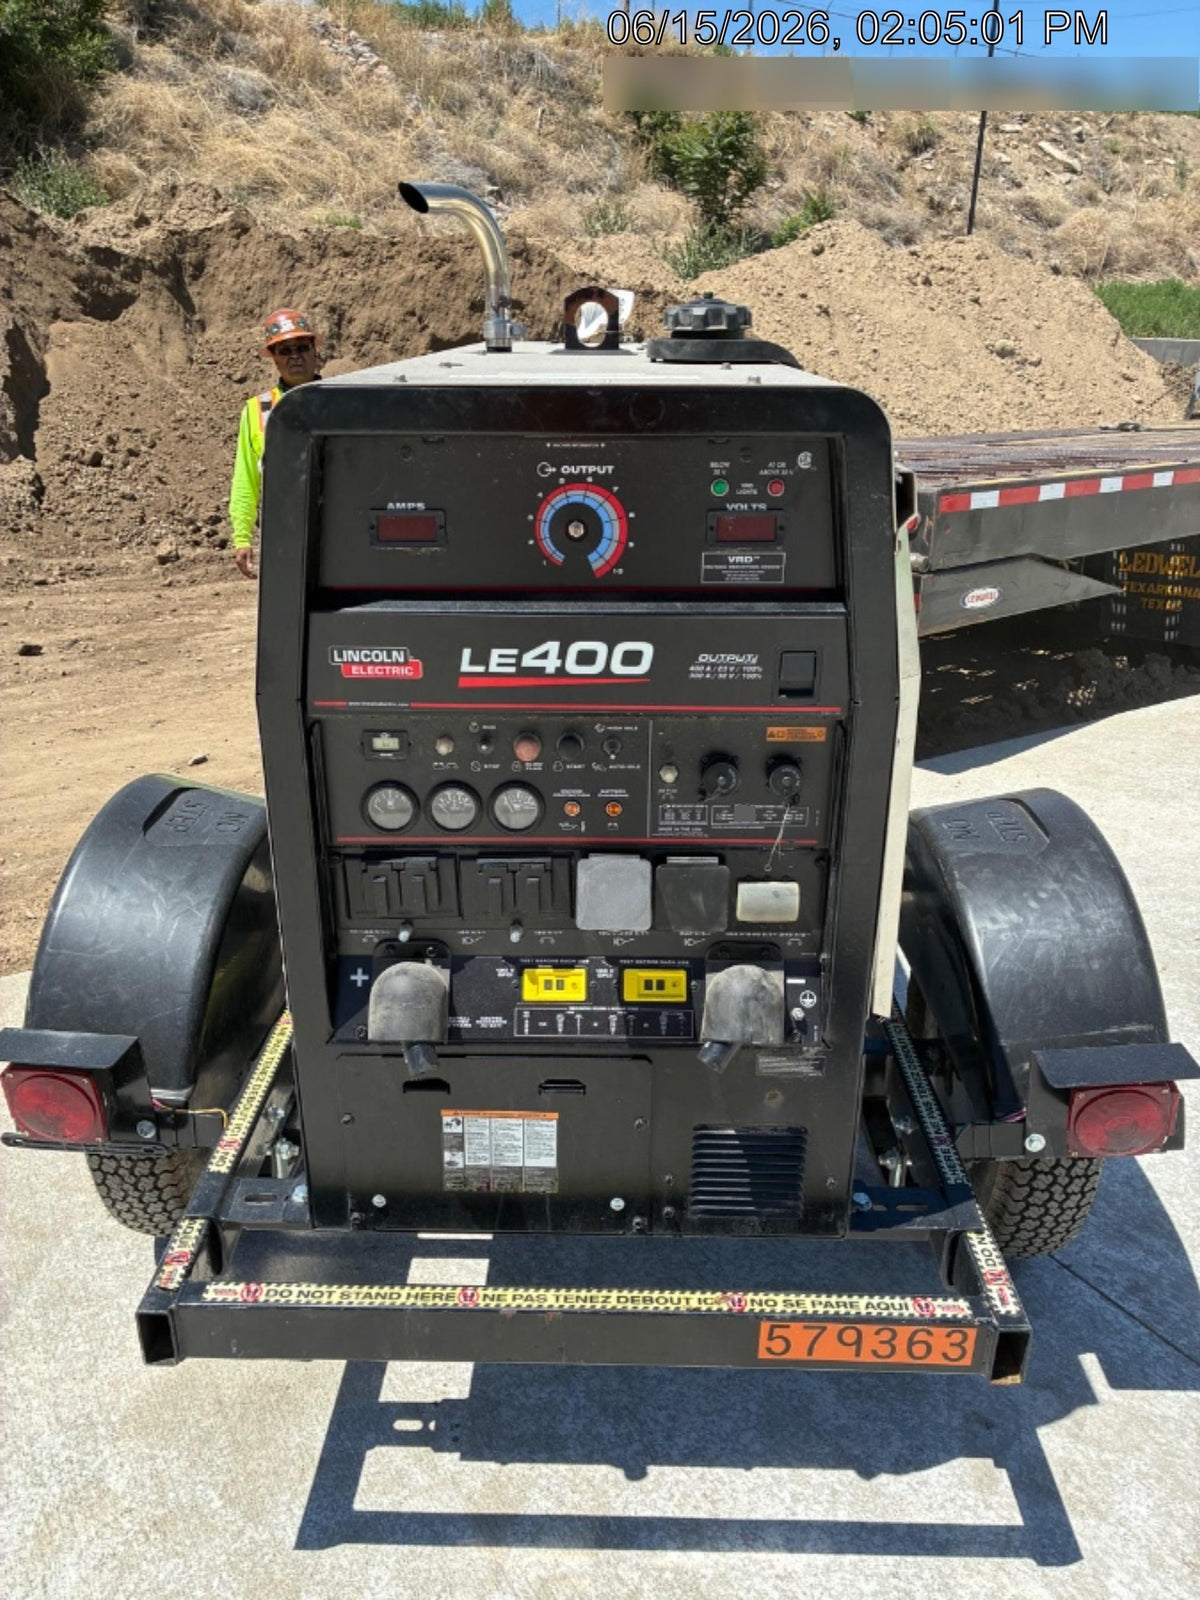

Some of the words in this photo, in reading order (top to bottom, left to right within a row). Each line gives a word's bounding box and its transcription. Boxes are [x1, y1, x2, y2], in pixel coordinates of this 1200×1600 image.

[561, 465, 615, 474] OUTPUT
[387, 502, 426, 510] AMPS
[726, 502, 768, 511] VOLTS
[333, 649, 405, 663] LINCOLN
[460, 641, 654, 674] LE400
[698, 654, 754, 662] OUTPUT
[351, 665, 414, 676] ELECTRIC
[265, 1289, 293, 1298] DO
[298, 1290, 336, 1299] NOT
[340, 1291, 400, 1300] STAND
[406, 1292, 456, 1301] HERE
[482, 1294, 507, 1302] NE
[511, 1294, 548, 1303] PAS
[554, 1295, 611, 1304] TENEZ
[616, 1296, 691, 1305] DEBOUT
[750, 1299, 778, 1308] NO
[782, 1300, 807, 1308] SE
[811, 1300, 860, 1310] PARE
[764, 1324, 970, 1362] 579363
